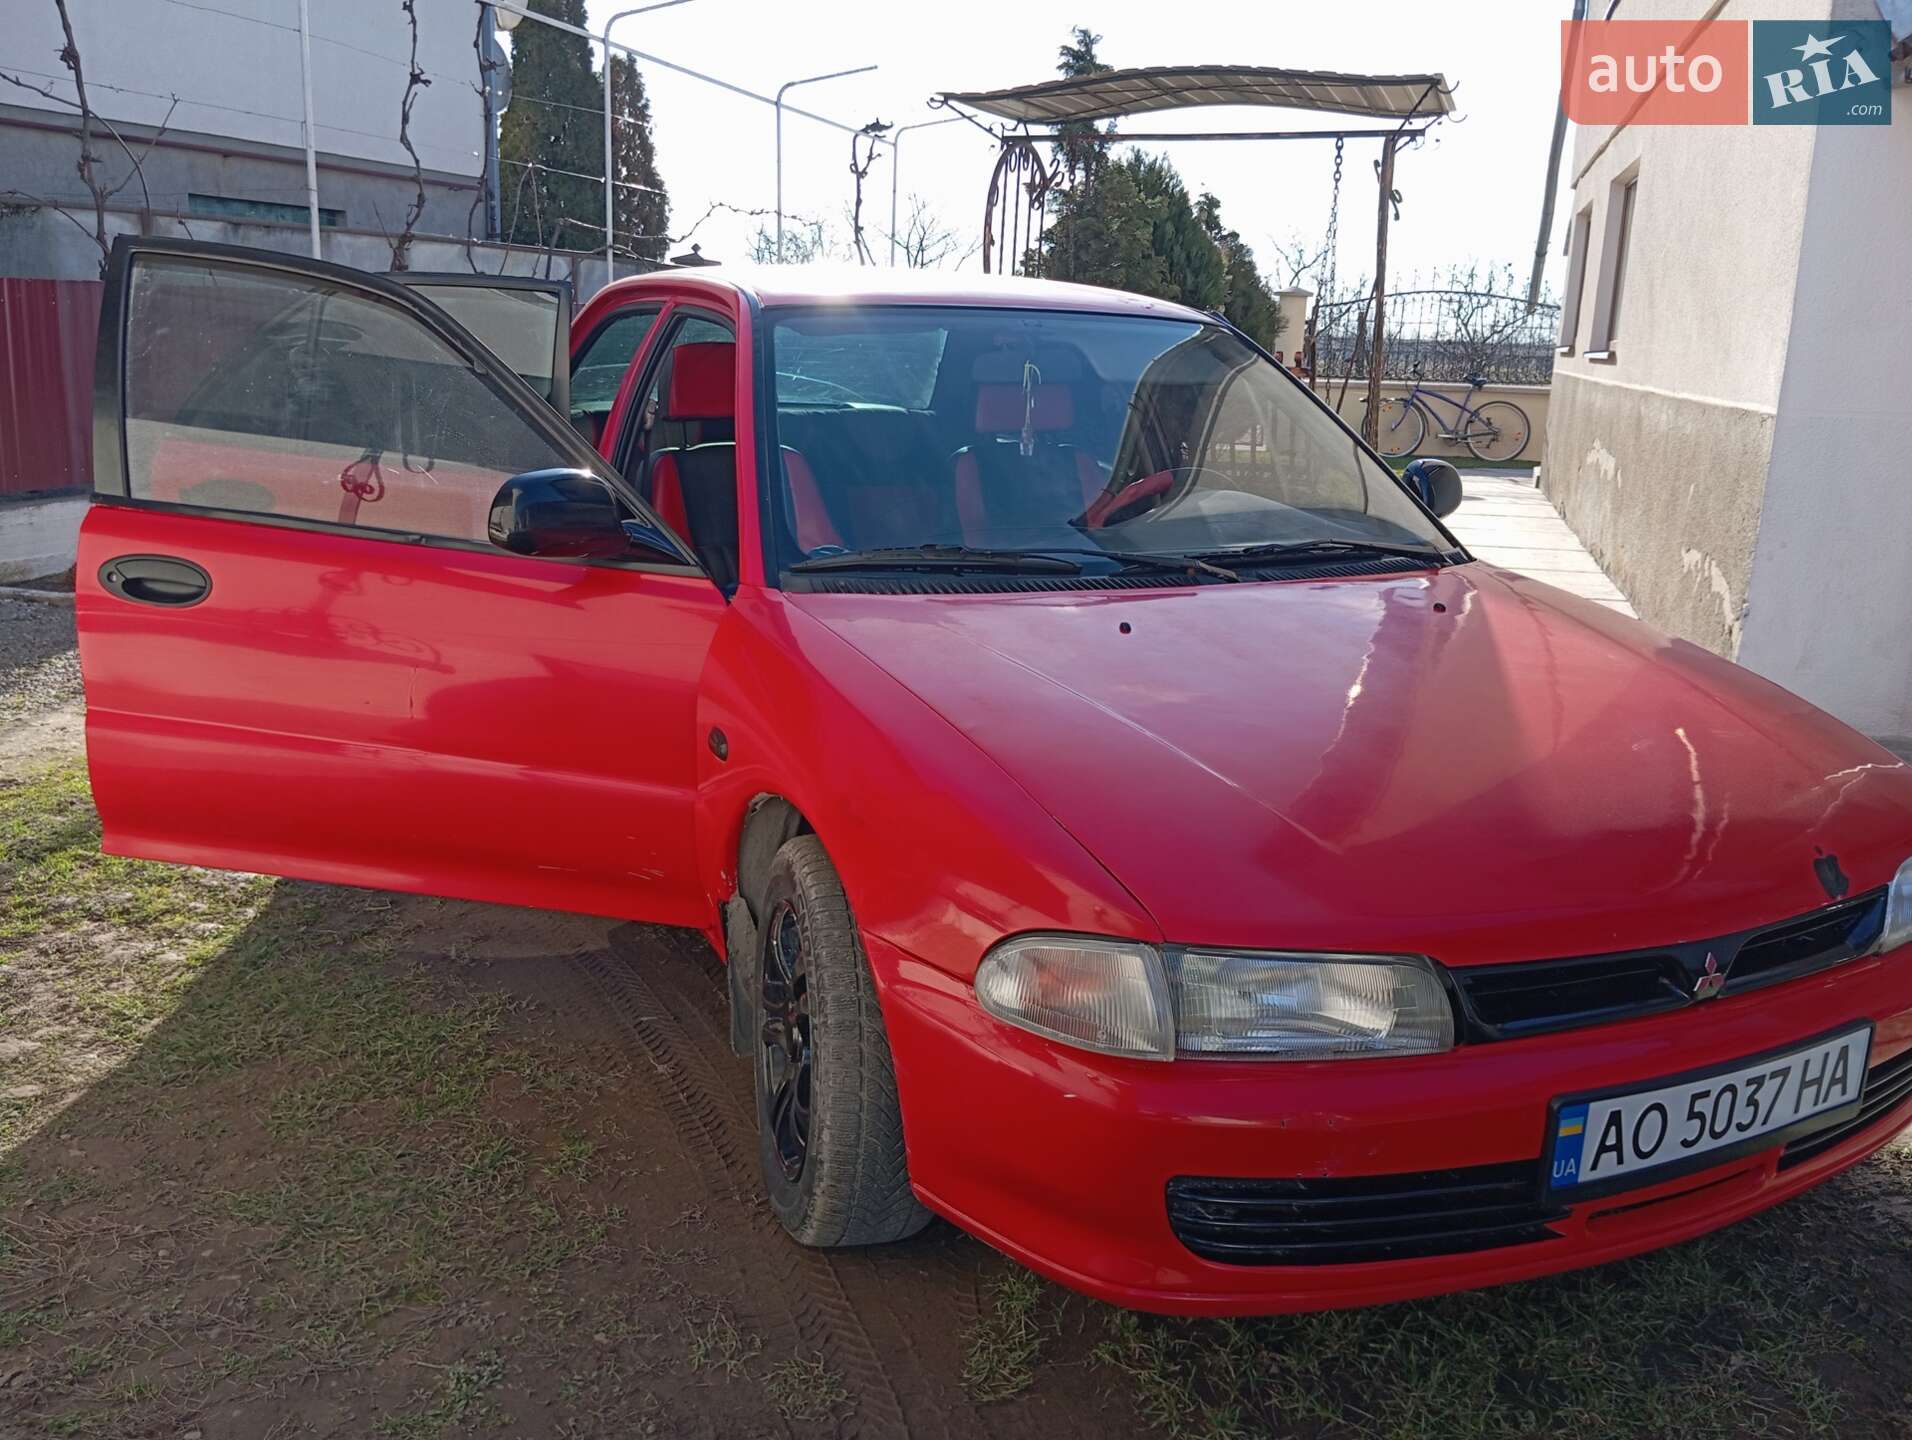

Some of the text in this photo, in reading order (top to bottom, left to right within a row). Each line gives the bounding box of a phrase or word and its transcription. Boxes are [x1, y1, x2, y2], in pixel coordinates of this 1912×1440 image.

[1589, 1045, 1851, 1172] AO 5037 HA
[1552, 1157, 1577, 1178] UA
